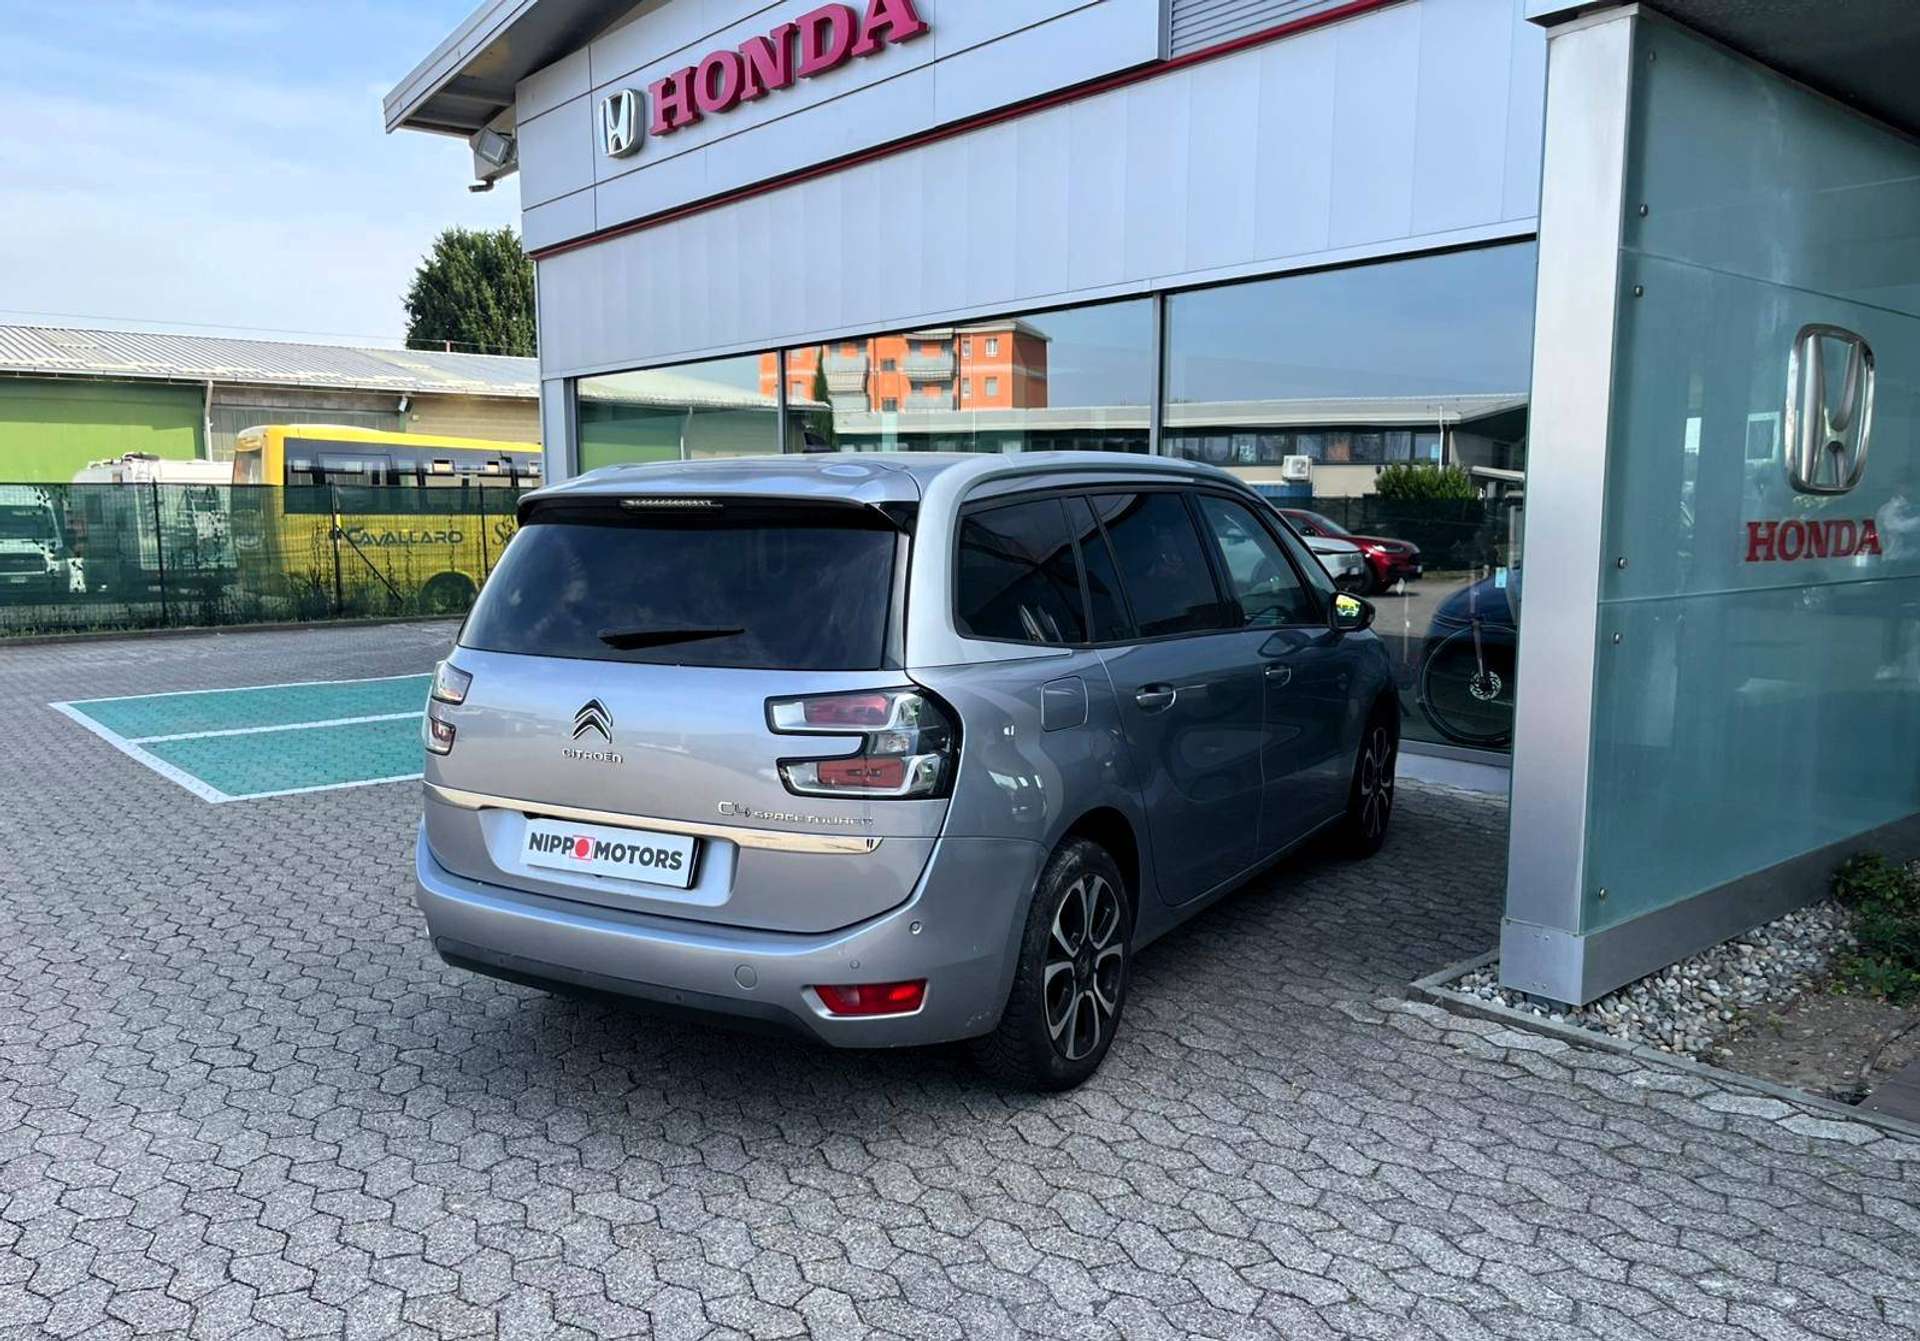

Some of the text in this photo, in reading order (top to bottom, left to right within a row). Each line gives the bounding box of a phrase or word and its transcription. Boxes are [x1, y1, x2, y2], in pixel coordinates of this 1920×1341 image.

[649, 0, 930, 136] HONDA
[1745, 518, 1882, 562] HONDA
[593, 840, 683, 871] MOTORS
